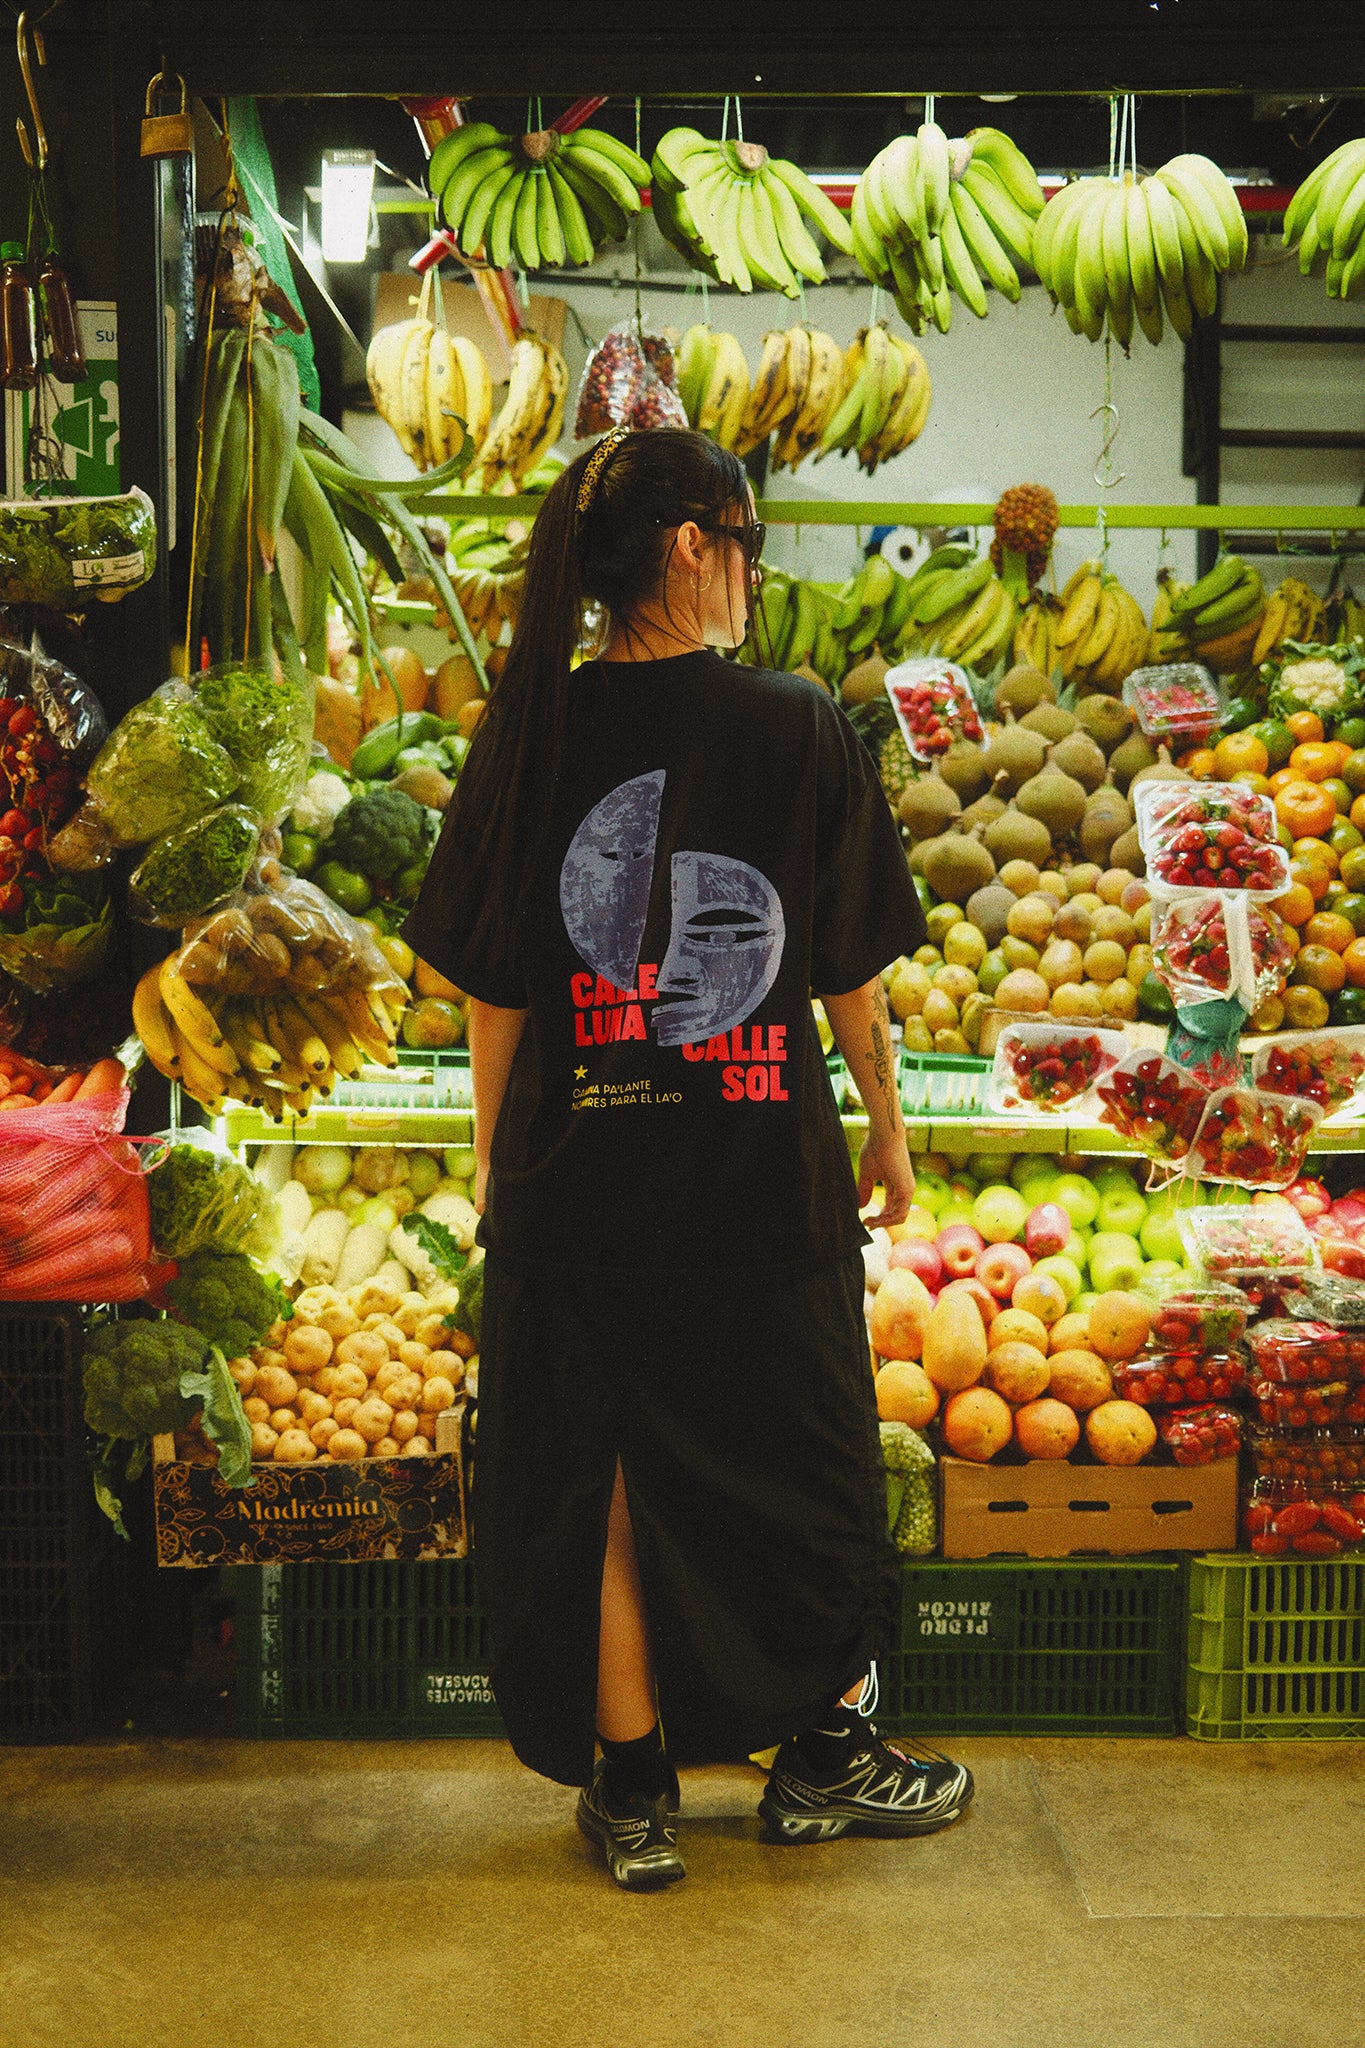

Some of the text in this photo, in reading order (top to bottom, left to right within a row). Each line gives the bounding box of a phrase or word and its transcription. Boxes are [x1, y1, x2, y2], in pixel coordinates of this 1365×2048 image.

[603, 1080, 651, 1094] PA'LANTE
[721, 1065, 789, 1102] SOL
[610, 1094, 637, 1106] PARA
[640, 1093, 652, 1103] EL
[656, 1092, 682, 1103] LA'O
[237, 1496, 378, 1520] Madremia
[920, 1619, 989, 1635] PEDRO
